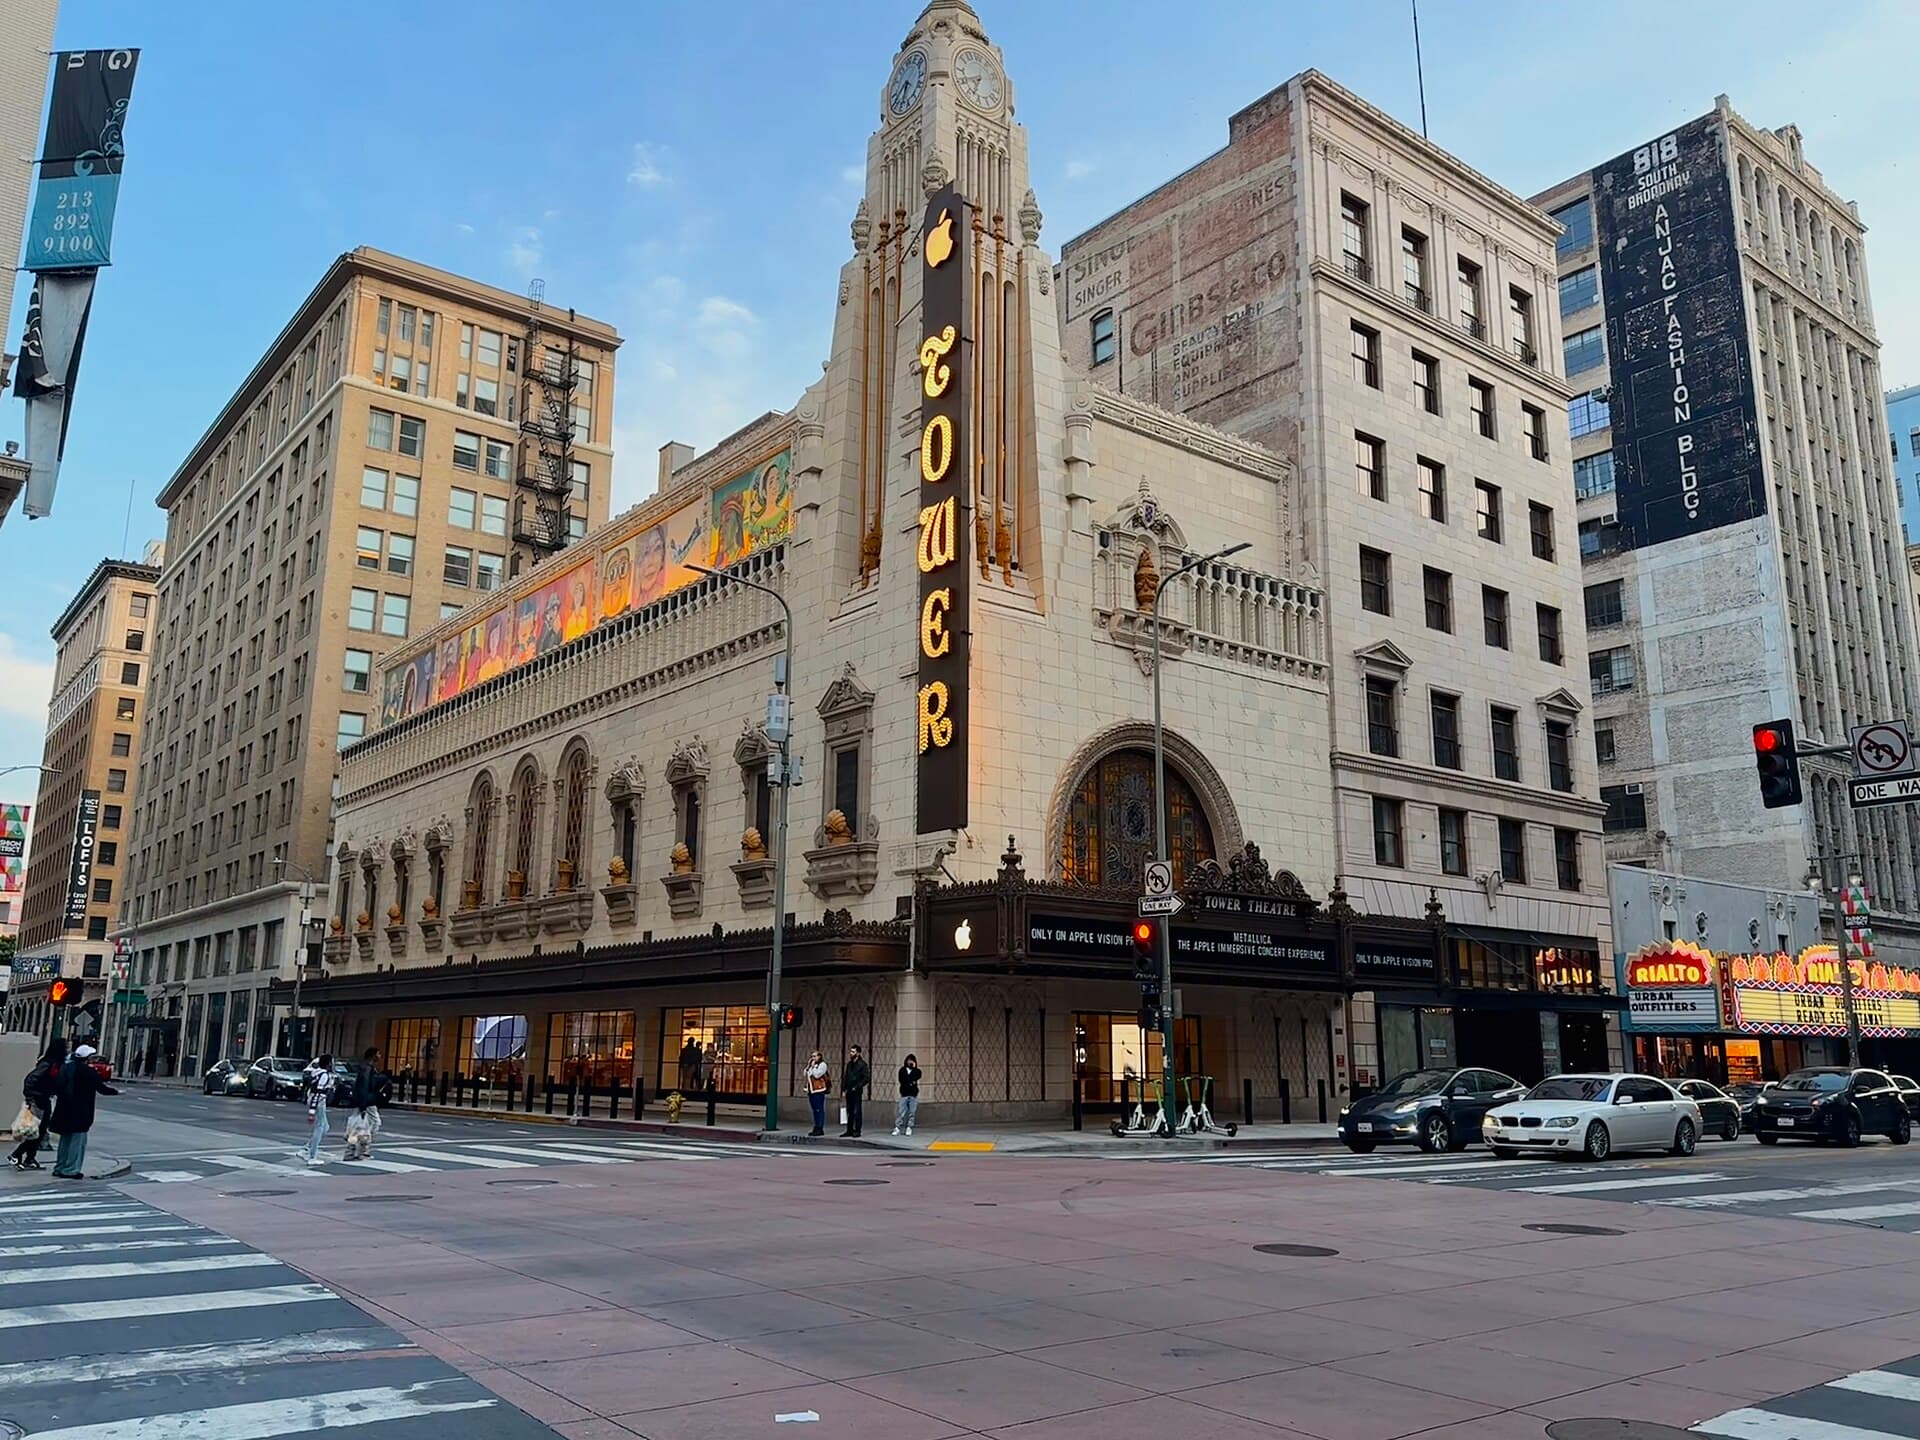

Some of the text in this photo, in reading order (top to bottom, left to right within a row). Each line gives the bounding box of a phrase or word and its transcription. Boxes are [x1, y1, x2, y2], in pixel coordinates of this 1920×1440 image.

[1634, 134, 1678, 175] 818
[1638, 163, 1677, 191] SOUTH
[1628, 171, 1691, 209] BROADWAY
[57, 192, 92, 208] 213
[54, 214, 90, 230] 892
[44, 236, 93, 253] 9100
[1075, 270, 1122, 307] SINGER
[1655, 204, 1699, 519] ANJAC FASHION BLDG.
[918, 325, 956, 754] TOWER
[1856, 778, 1920, 800] ONE WA
[77, 823, 93, 886] LOFTS
[1144, 901, 1172, 910] ONE WAY
[1205, 896, 1297, 916] TOWER THEATRE
[1031, 928, 1135, 946] ONLY ON APPLE VISION PR
[1233, 932, 1272, 944] METALLICA
[1178, 940, 1325, 961] THE APPLE IMMERSIVE CONCERT EXPERIENCE
[1356, 953, 1433, 968] ONLY ON APPLE VISION PRO
[1636, 964, 1700, 983] RIALTO
[1807, 962, 1863, 986] RIALO
[1634, 992, 1674, 1001] URBAN
[1720, 961, 1734, 1022] RIALTO
[1631, 1002, 1697, 1012] OUTFITTERS
[1794, 994, 1882, 1011] URBAN OUITTERS
[1796, 1010, 1826, 1023] READY
[1830, 1012, 1845, 1024] SET
